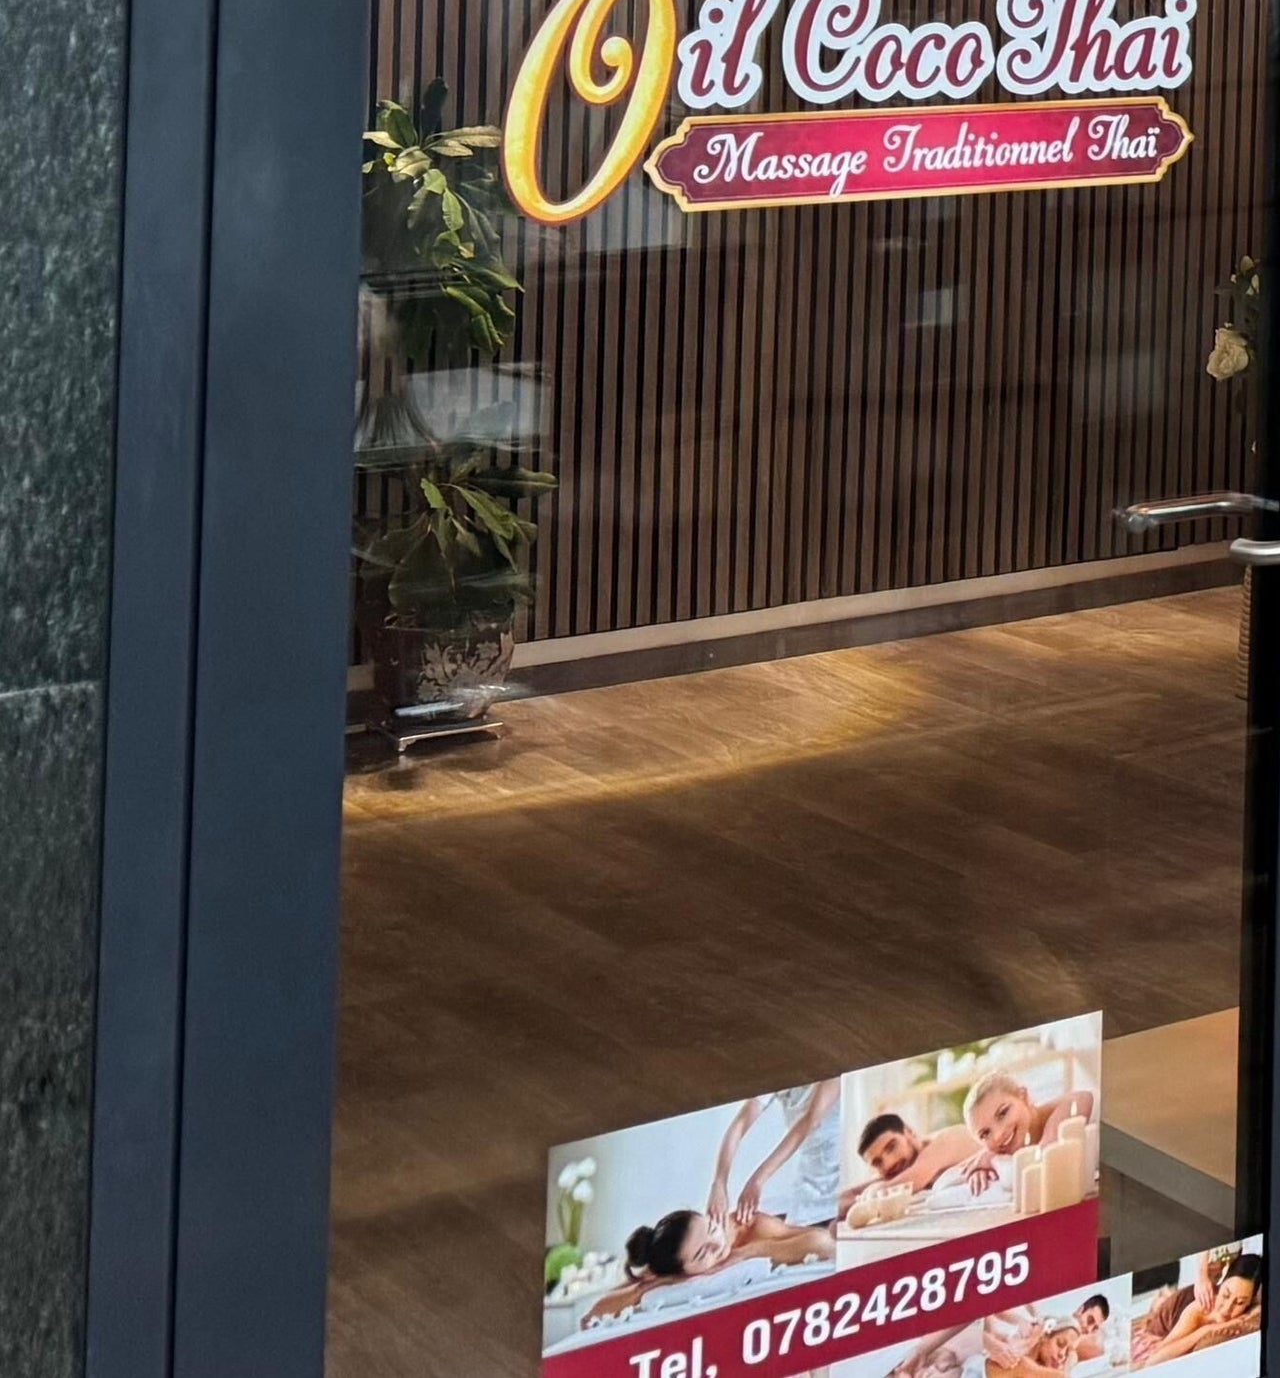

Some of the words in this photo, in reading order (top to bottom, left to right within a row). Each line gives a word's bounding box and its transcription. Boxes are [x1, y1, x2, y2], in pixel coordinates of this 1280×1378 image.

[693, 132, 868, 198] Massage
[883, 117, 1081, 172] Traditionnel
[1087, 115, 1160, 160] Thaï
[629, 1336, 718, 1378] Tel,
[742, 1242, 1030, 1365] 0782428795
